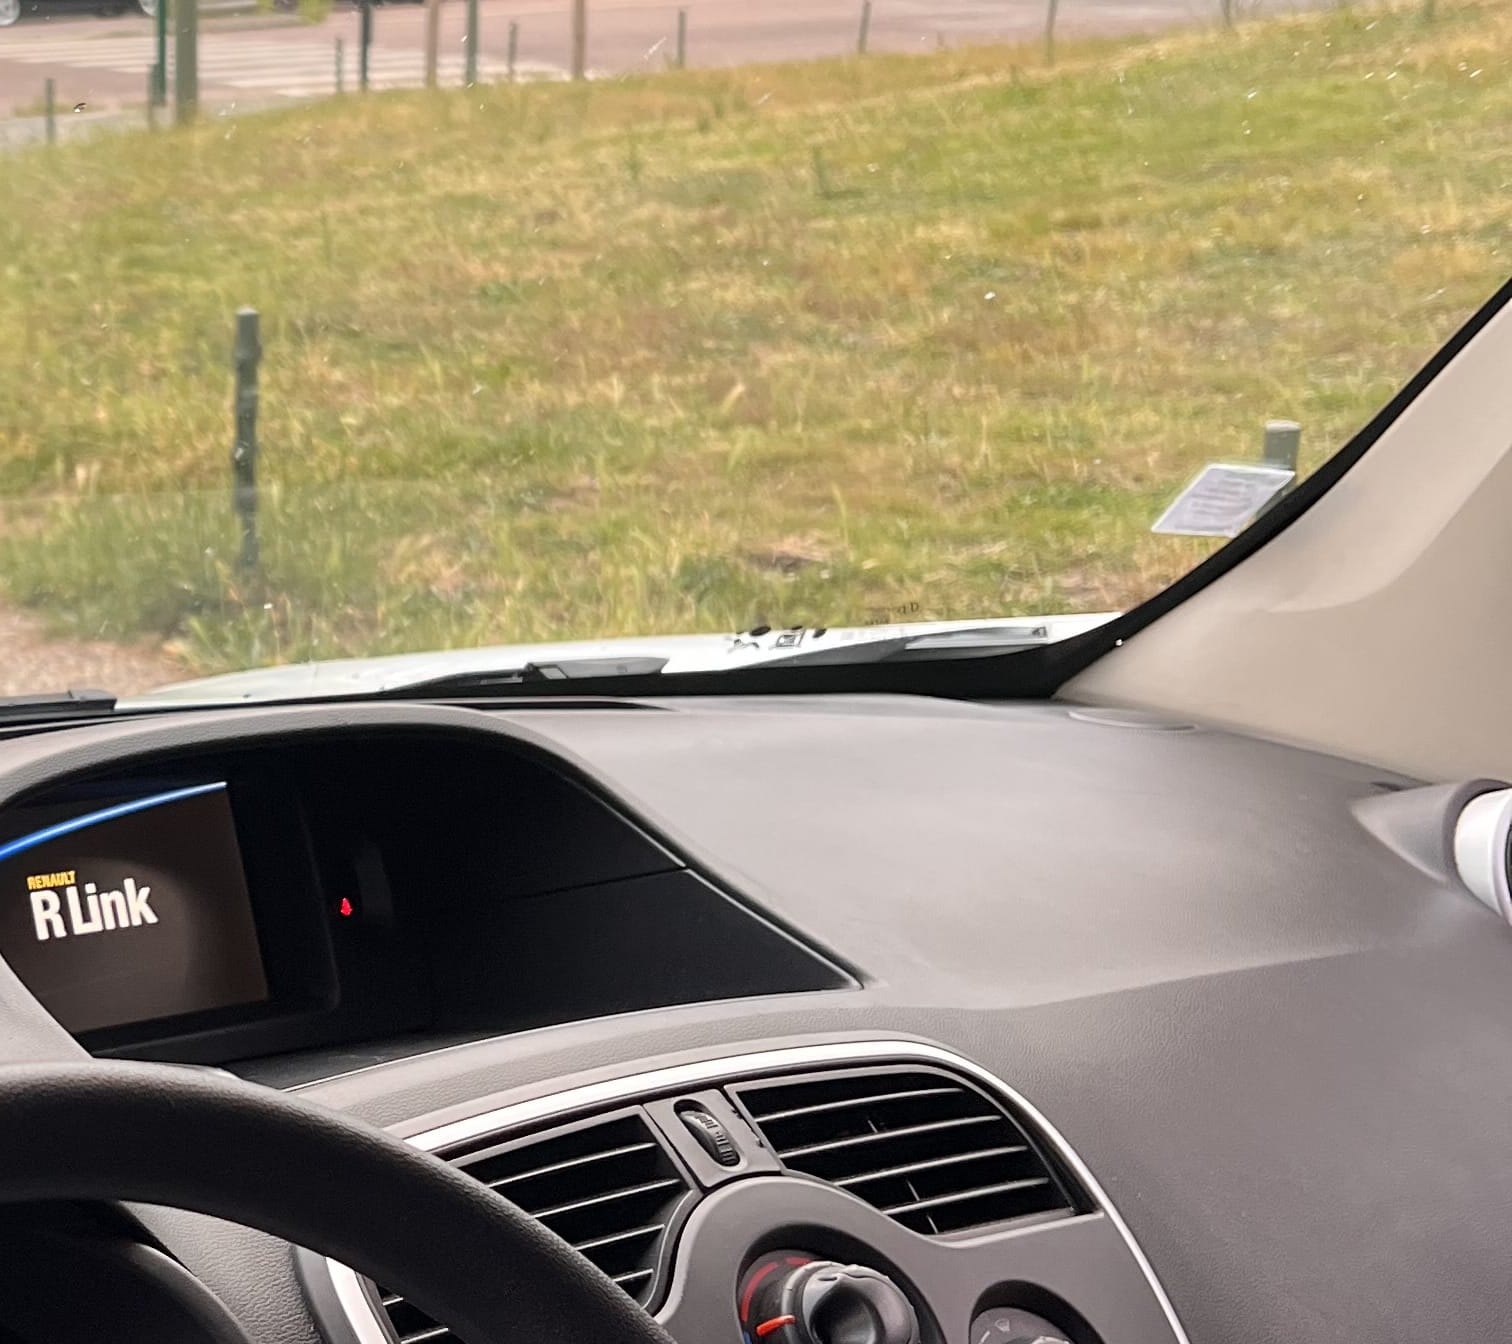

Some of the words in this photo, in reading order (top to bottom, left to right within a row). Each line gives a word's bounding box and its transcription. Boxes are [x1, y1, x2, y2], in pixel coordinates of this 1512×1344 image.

[27, 870, 76, 891] RENAULT
[30, 889, 67, 941] R
[66, 877, 159, 935] Link
